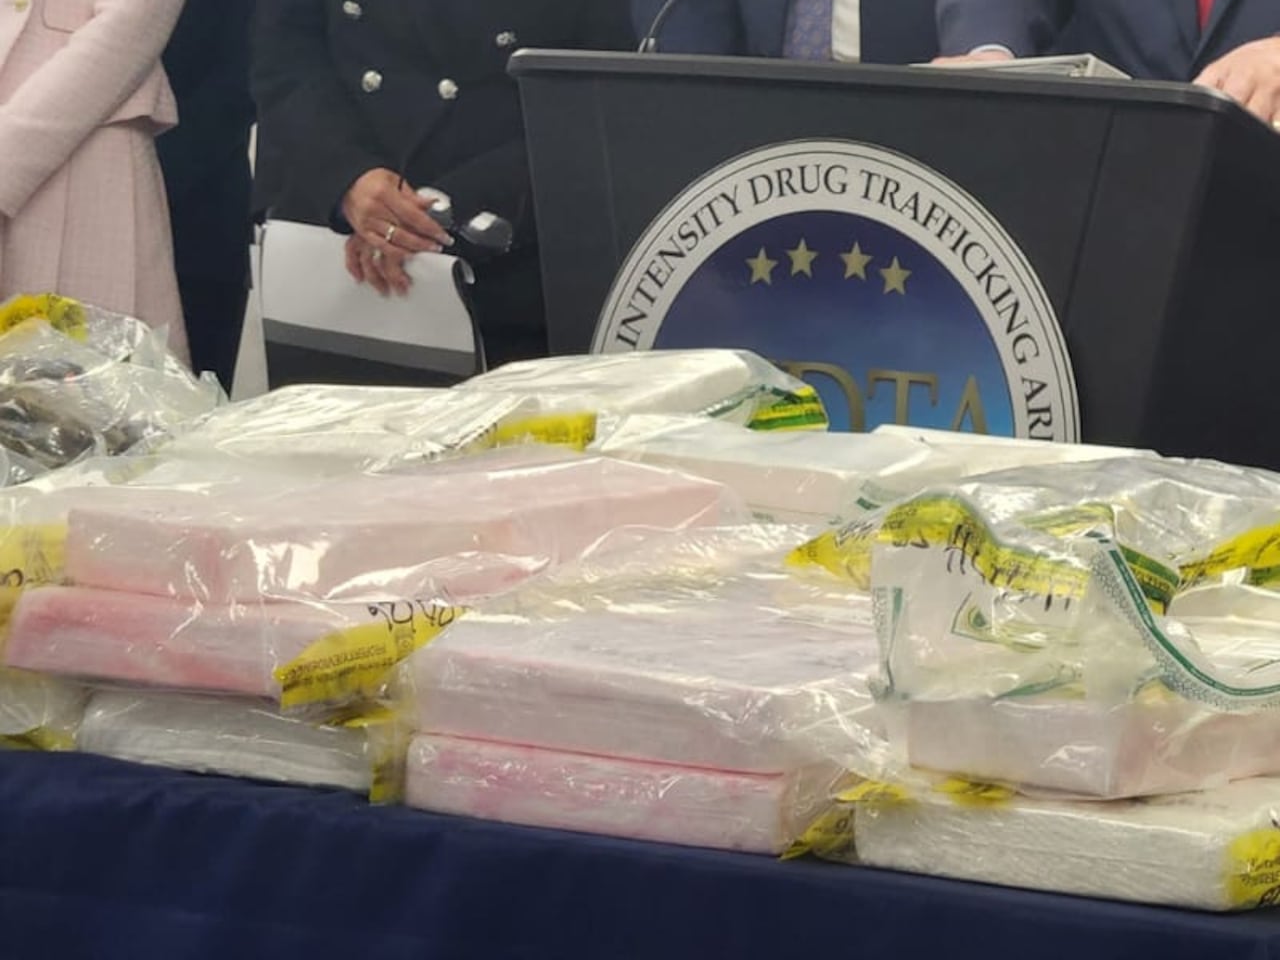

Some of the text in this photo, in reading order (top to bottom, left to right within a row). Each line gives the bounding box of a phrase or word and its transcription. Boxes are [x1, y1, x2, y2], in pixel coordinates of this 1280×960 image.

[615, 184, 741, 348] INTENSITY
[747, 164, 849, 206] DRUG
[859, 169, 1040, 365] TRAFFICKING
